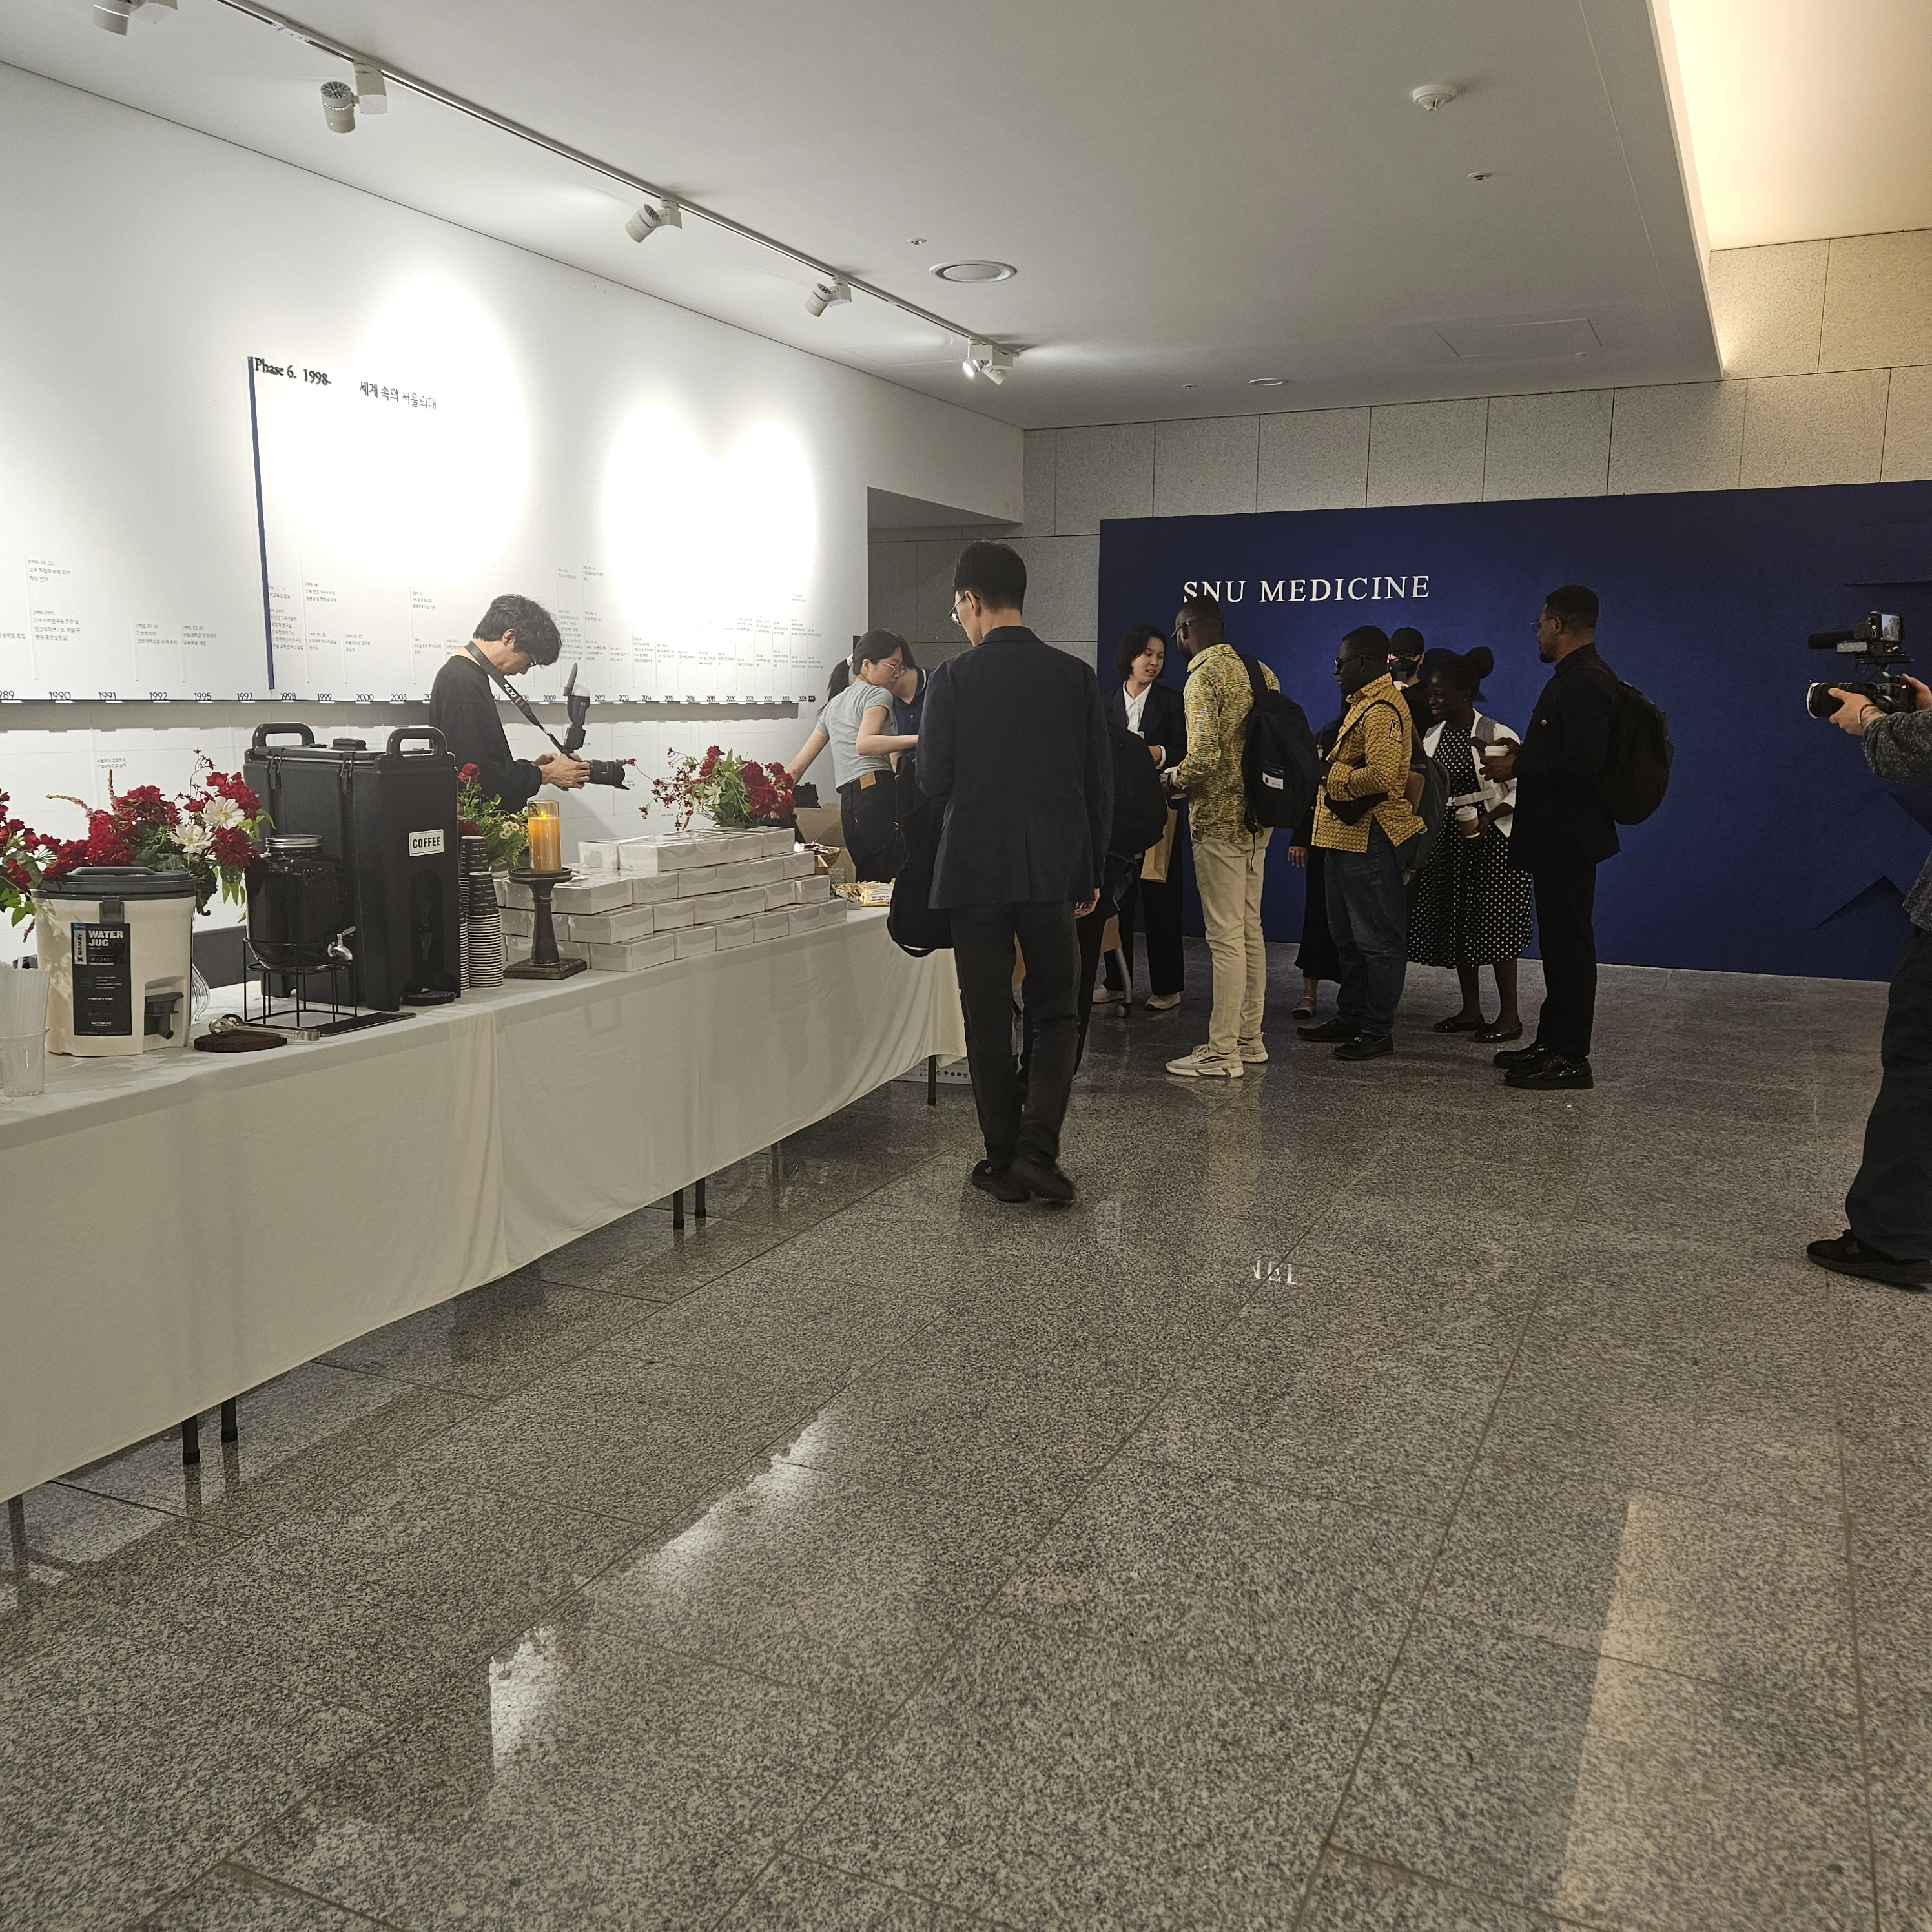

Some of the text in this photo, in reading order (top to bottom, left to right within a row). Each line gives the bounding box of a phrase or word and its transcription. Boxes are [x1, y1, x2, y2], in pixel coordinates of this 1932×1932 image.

[254, 357, 332, 385] Phase 6. 1998-
[359, 381, 437, 410] 세계 속의 서울의대
[1184, 575, 1430, 602] SNU MEDICINE
[49, 691, 71, 701] 1990
[98, 692, 117, 701] 1991
[149, 692, 168, 701] 1992
[194, 692, 212, 701] 1995
[236, 692, 253, 701] 1997
[280, 692, 296, 701] 1998
[317, 693, 332, 701] 1999
[356, 694, 375, 702] 2000
[390, 694, 407, 702] 2003
[413, 836, 441, 848] COFFEE
[88, 938, 109, 947] JUG
